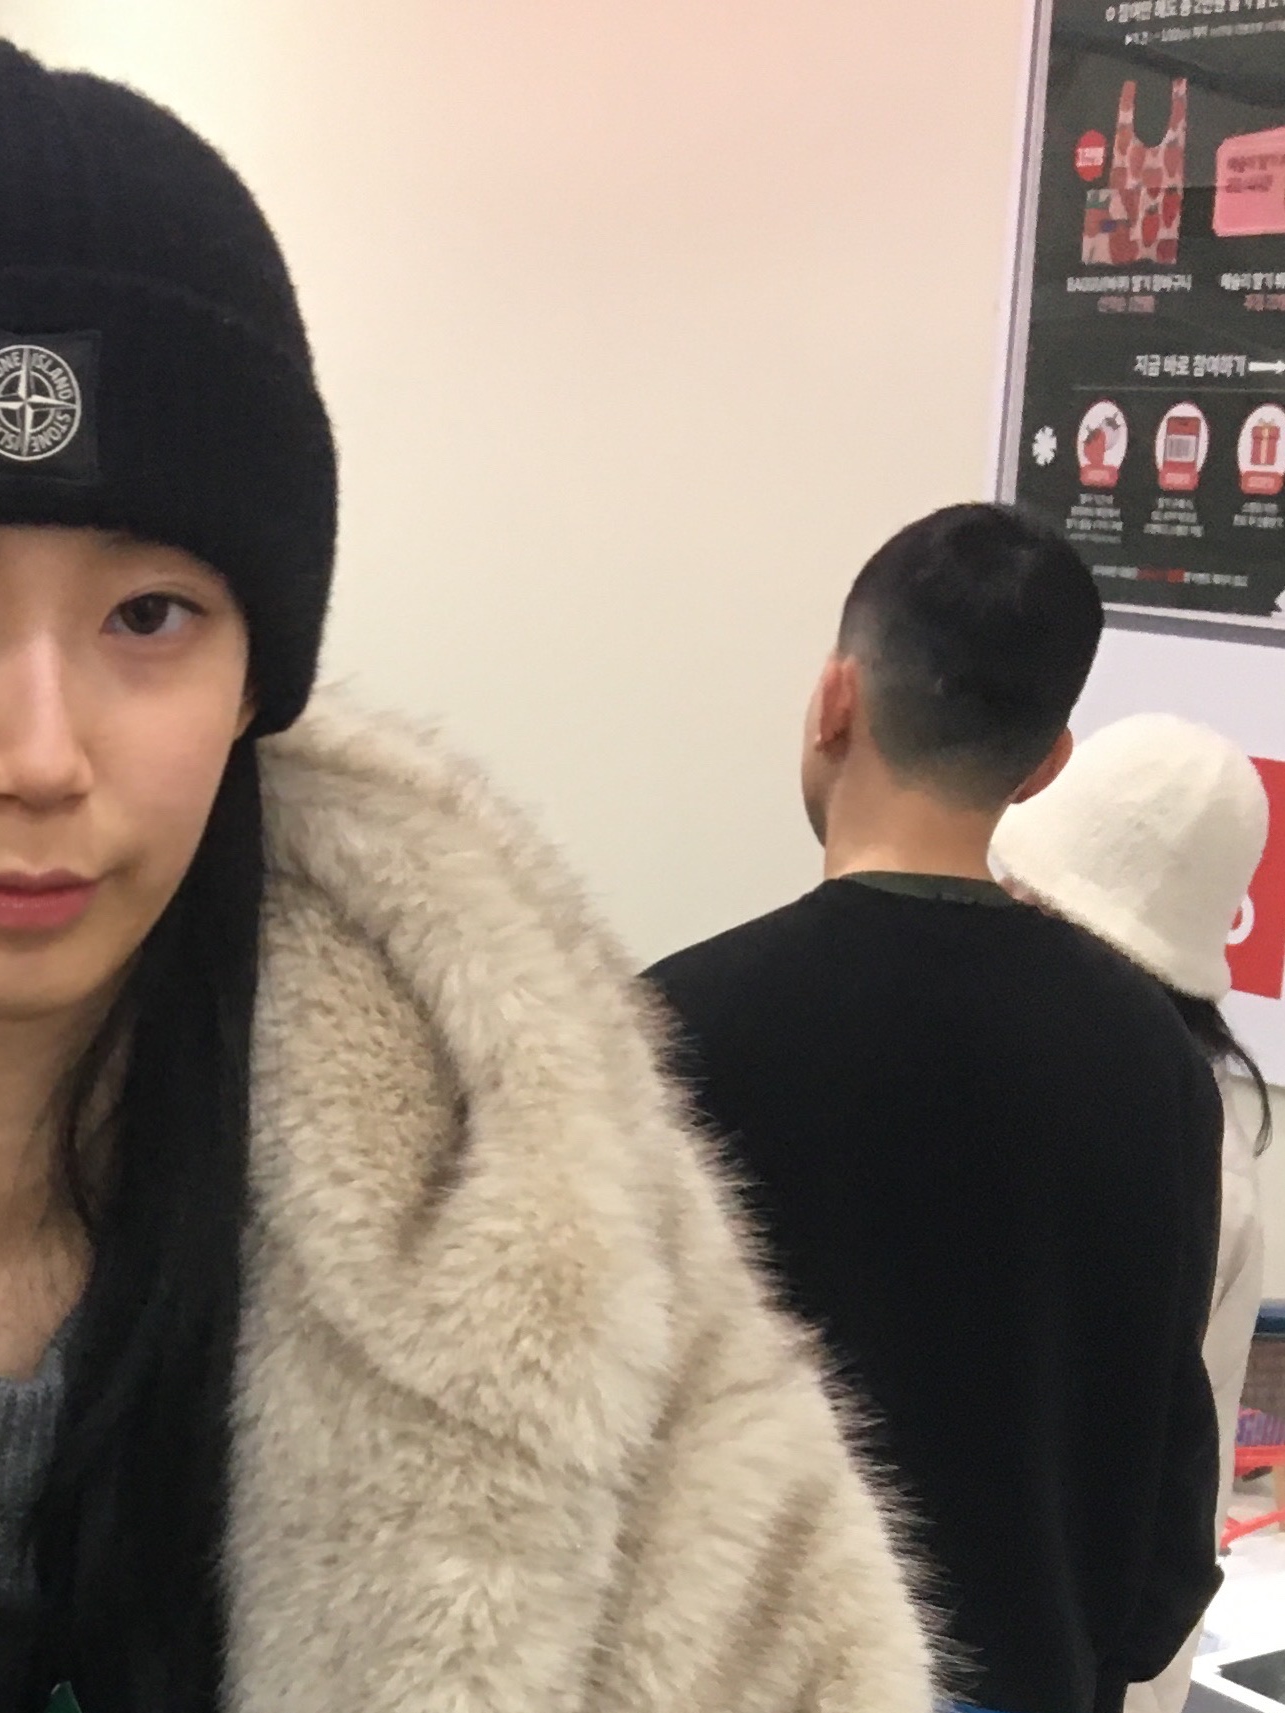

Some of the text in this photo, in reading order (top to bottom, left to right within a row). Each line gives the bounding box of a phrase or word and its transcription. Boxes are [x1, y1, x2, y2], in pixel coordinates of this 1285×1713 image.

[31, 352, 74, 400] ISLAND
[1134, 354, 1247, 377] 지금 바로 참여하기
[31, 411, 72, 453] STONE
